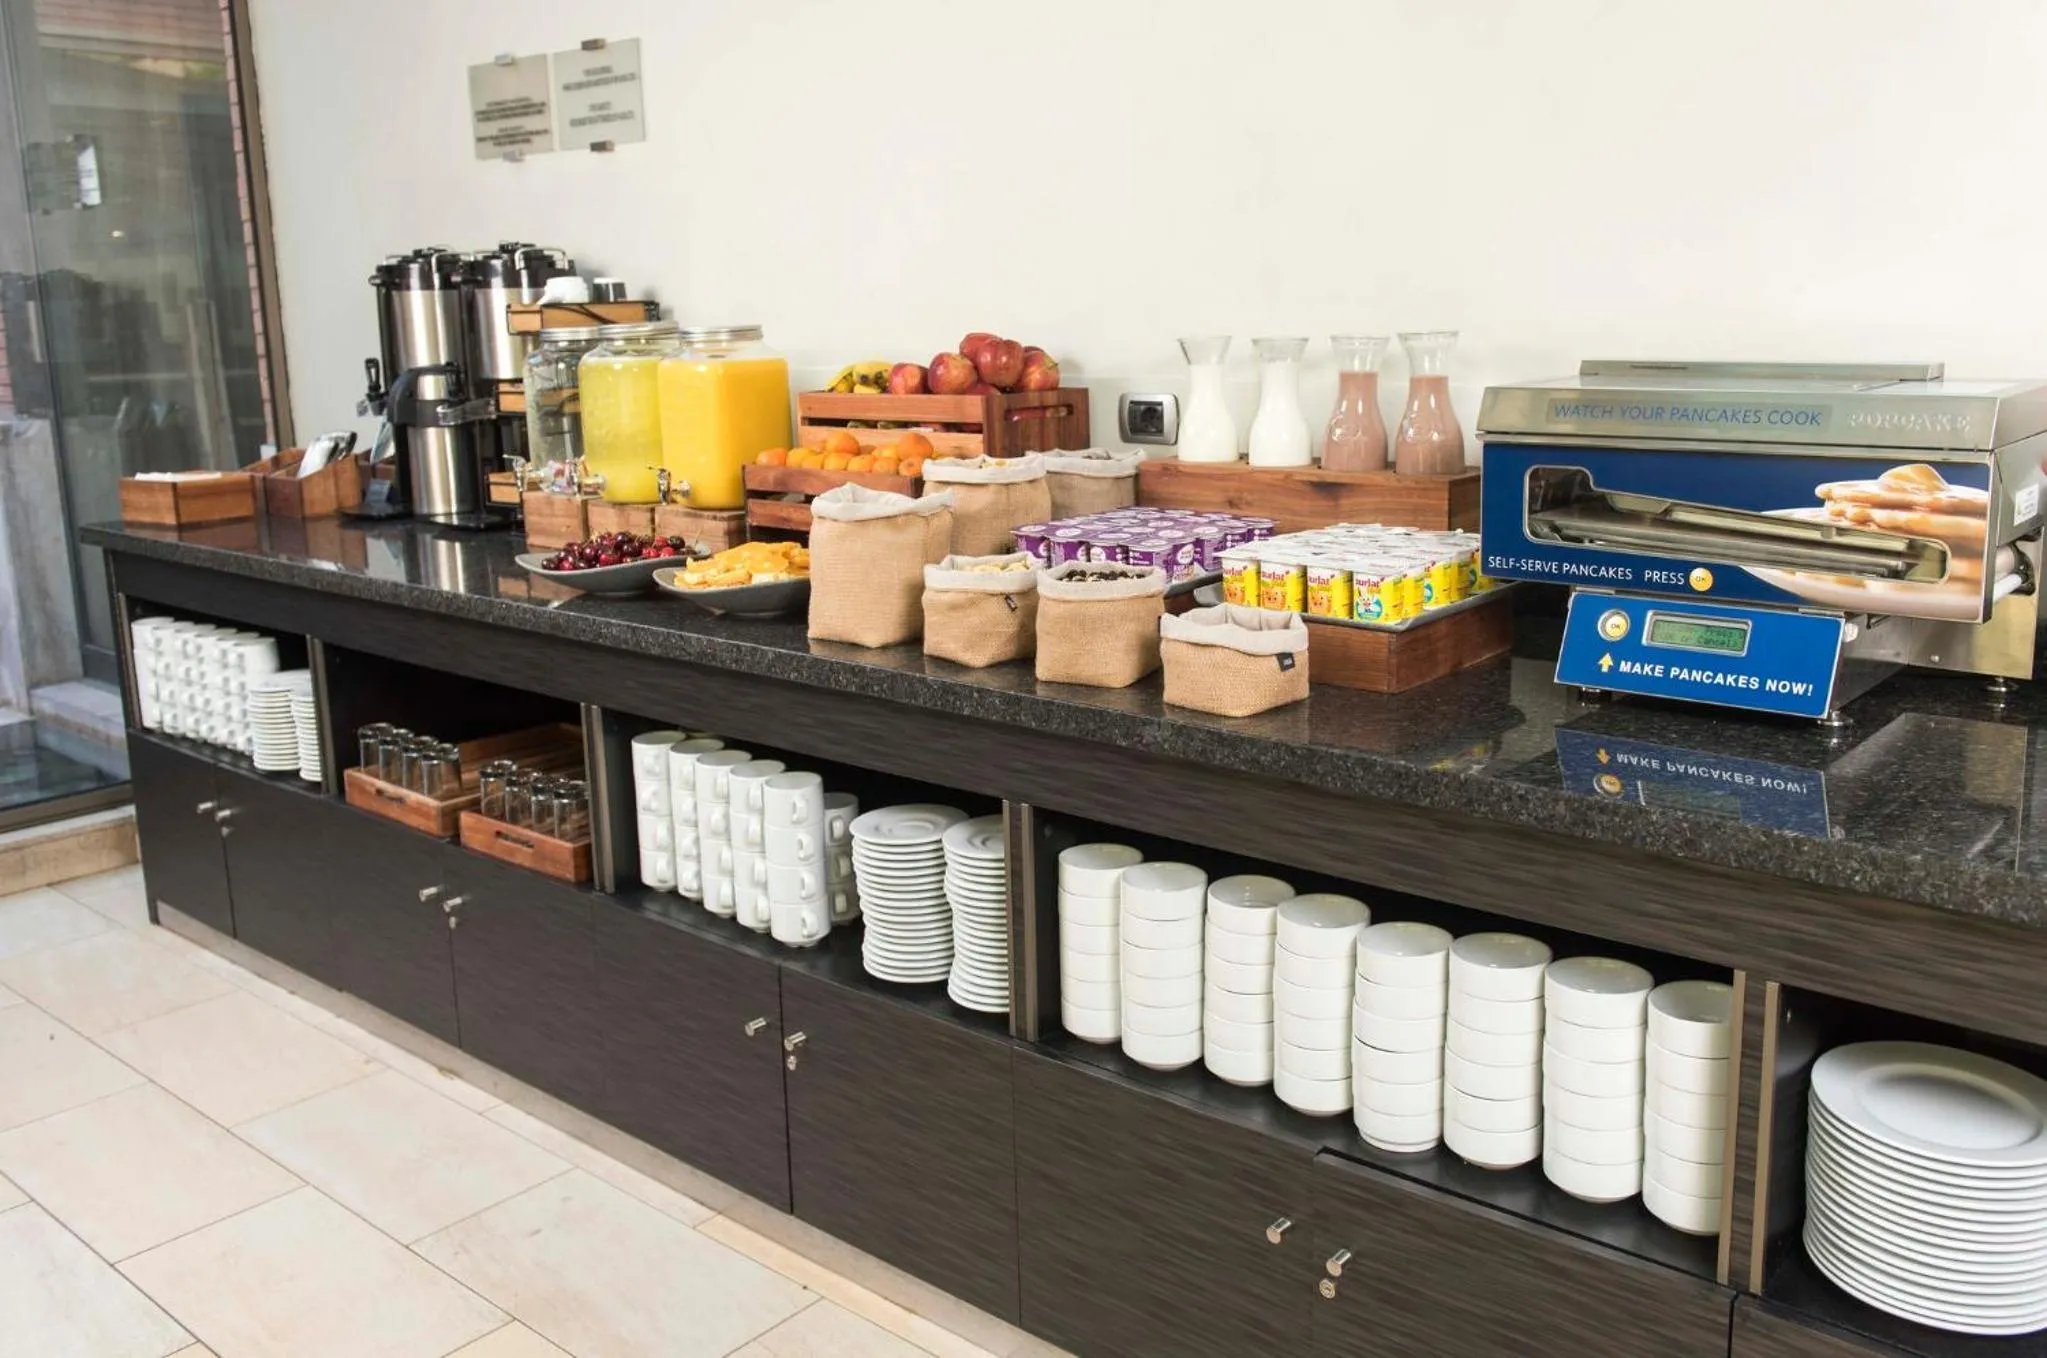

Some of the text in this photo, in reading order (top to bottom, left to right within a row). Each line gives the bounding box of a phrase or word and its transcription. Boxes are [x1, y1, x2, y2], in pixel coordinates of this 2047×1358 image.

[1554, 404, 1823, 426] WATCH YOUR PANCAKES COOK
[1488, 556, 1559, 574] SELF-SERVE
[1562, 562, 1633, 581] PANCAKES
[1644, 569, 1685, 585] PRESS
[1618, 659, 1814, 697] MAKE PANCAKES NOW!
